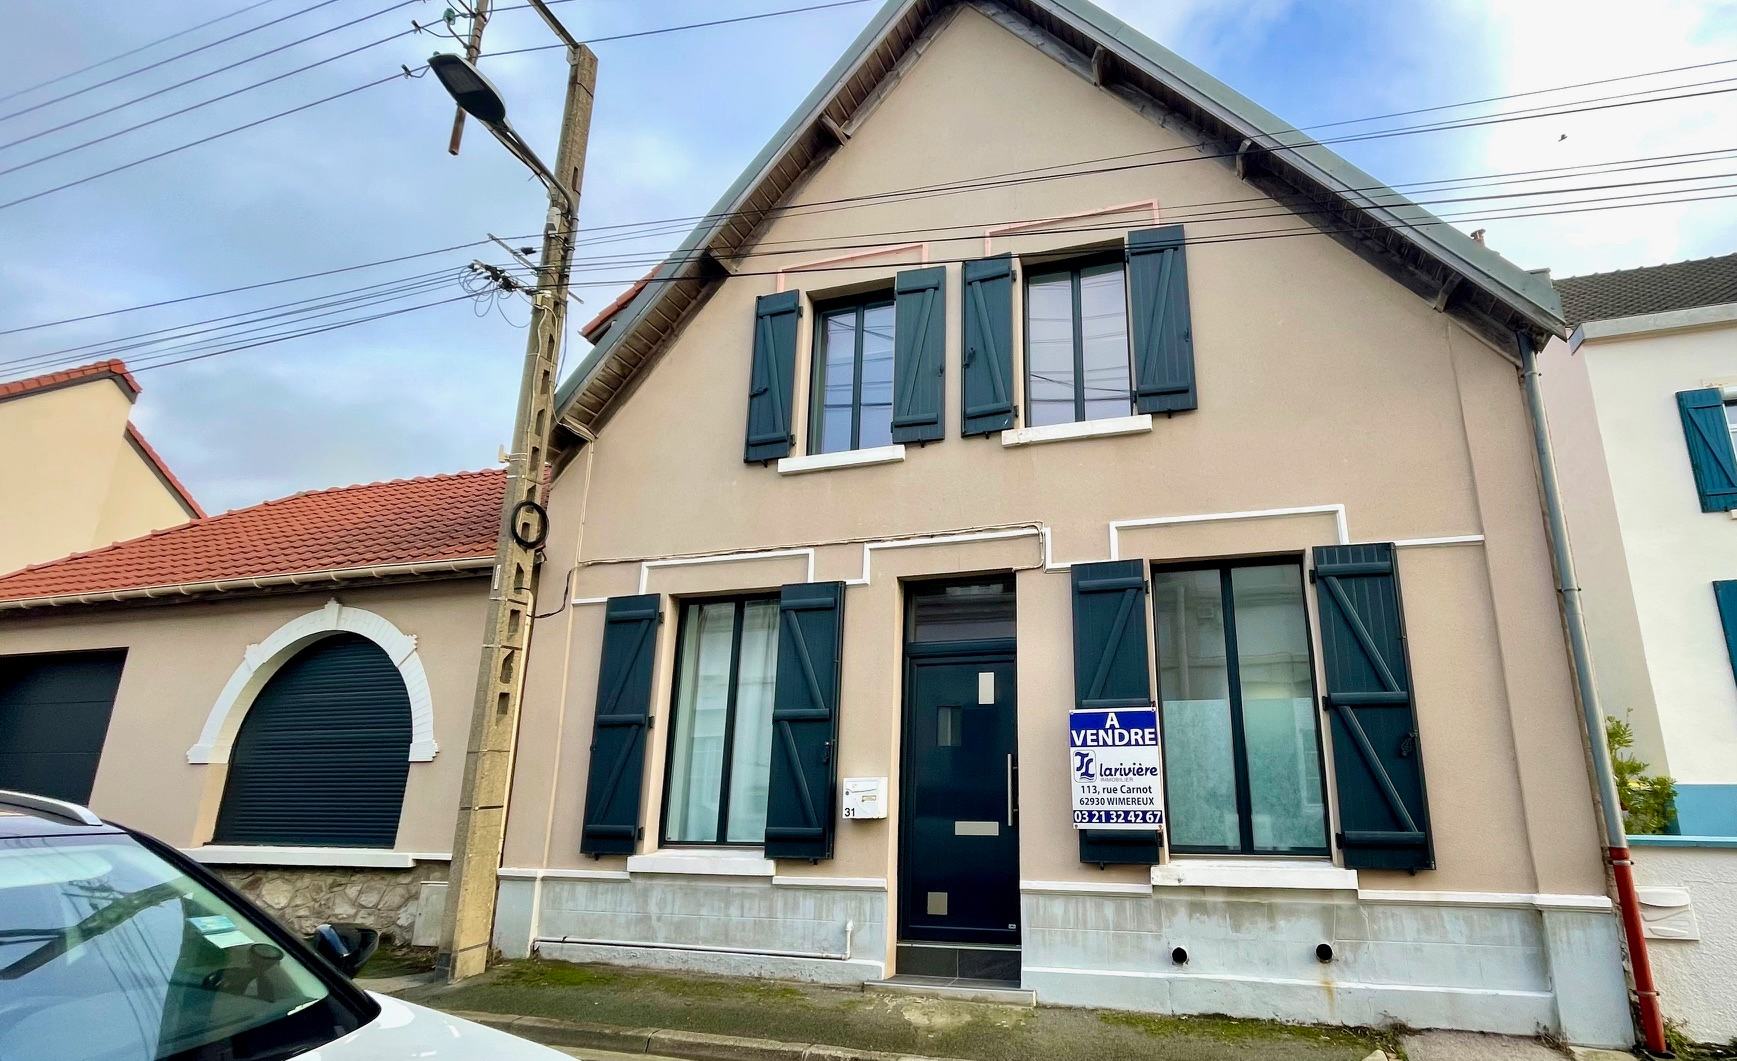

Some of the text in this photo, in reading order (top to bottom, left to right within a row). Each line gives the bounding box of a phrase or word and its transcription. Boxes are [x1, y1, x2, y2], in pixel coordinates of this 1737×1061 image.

[1105, 713, 1120, 728] A
[1071, 729, 1156, 746] VENDRE
[1099, 763, 1158, 777] larivière
[1081, 785, 1100, 795] 113,
[1120, 785, 1152, 794] Carnot
[1080, 797, 1154, 806] 62930 WIMEREUX
[844, 807, 855, 817] 31
[1074, 811, 1161, 822] 03 21 32 42 67
